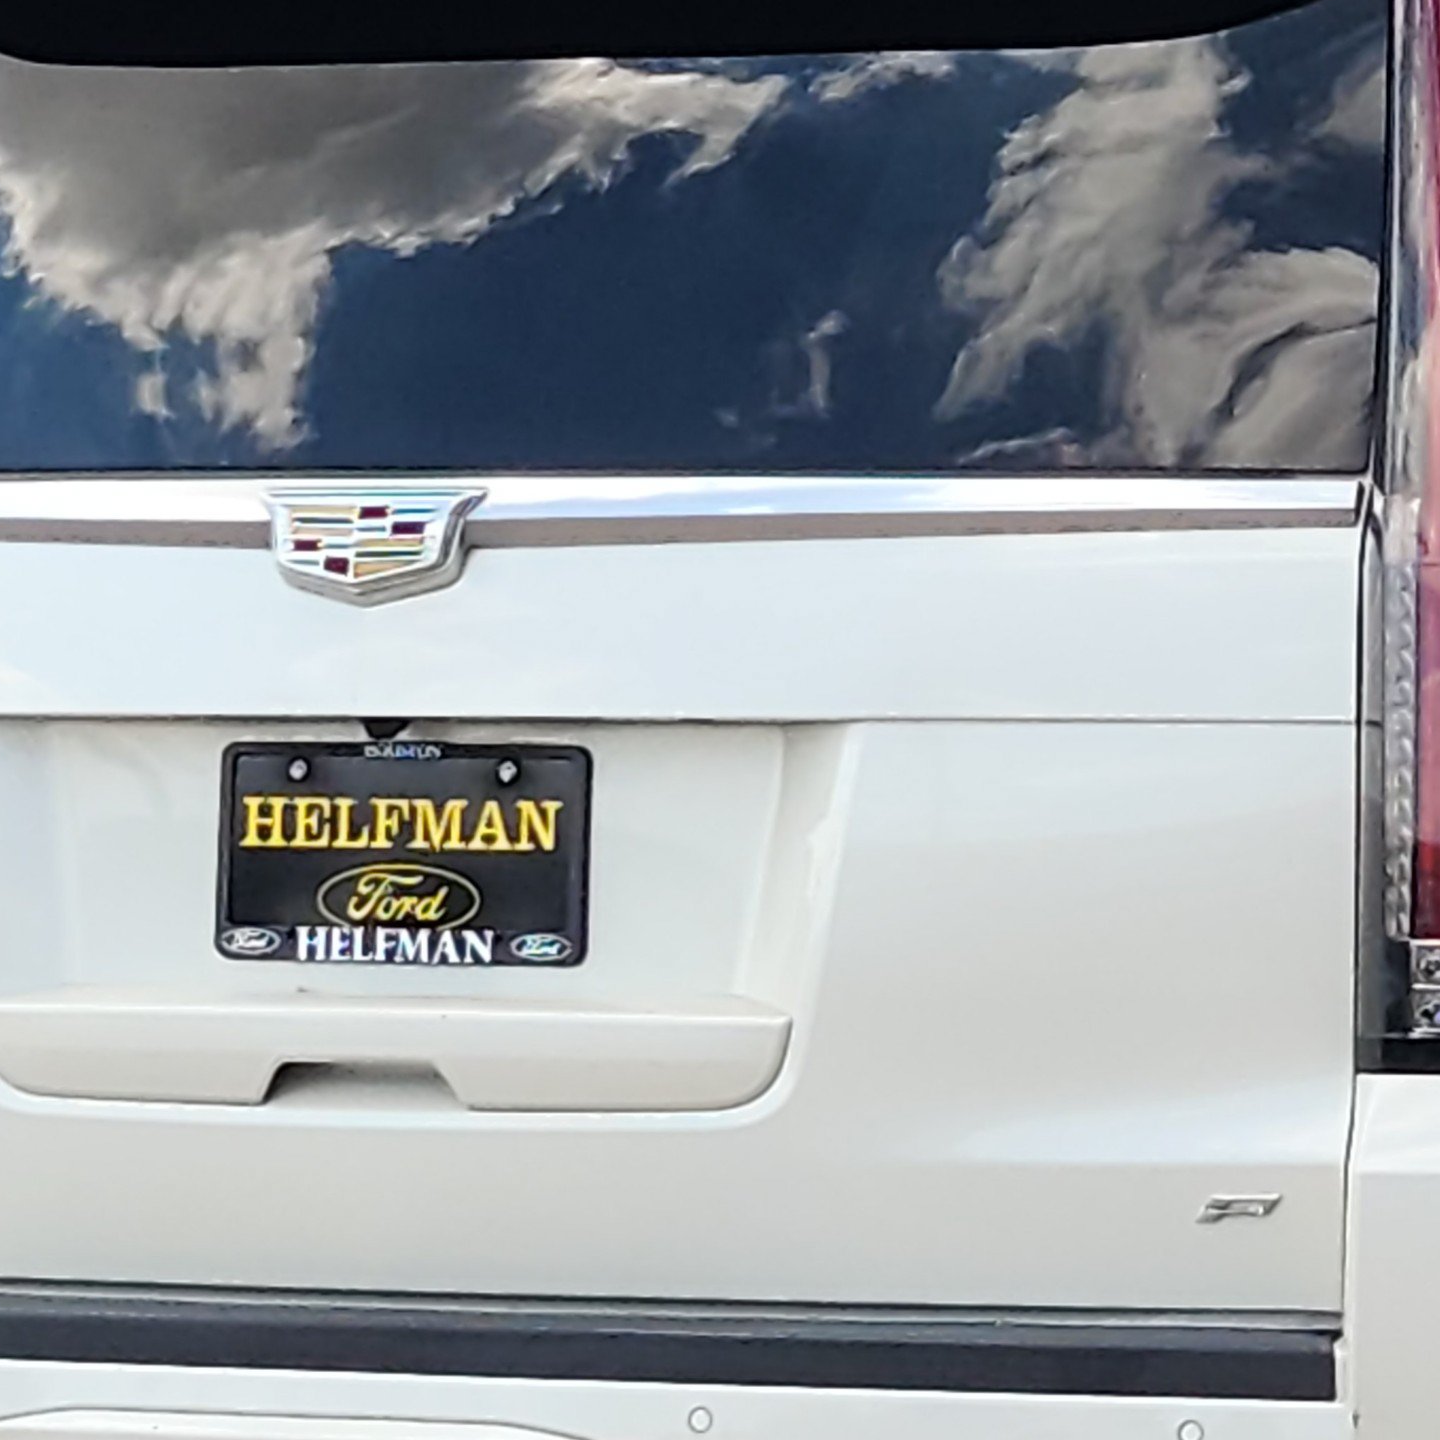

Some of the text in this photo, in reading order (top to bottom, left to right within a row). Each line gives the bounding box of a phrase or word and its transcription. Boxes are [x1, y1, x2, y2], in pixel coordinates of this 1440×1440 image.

[238, 795, 564, 853] HELFMAN
[345, 871, 449, 923] Ford
[294, 925, 495, 964] HELFMAN
